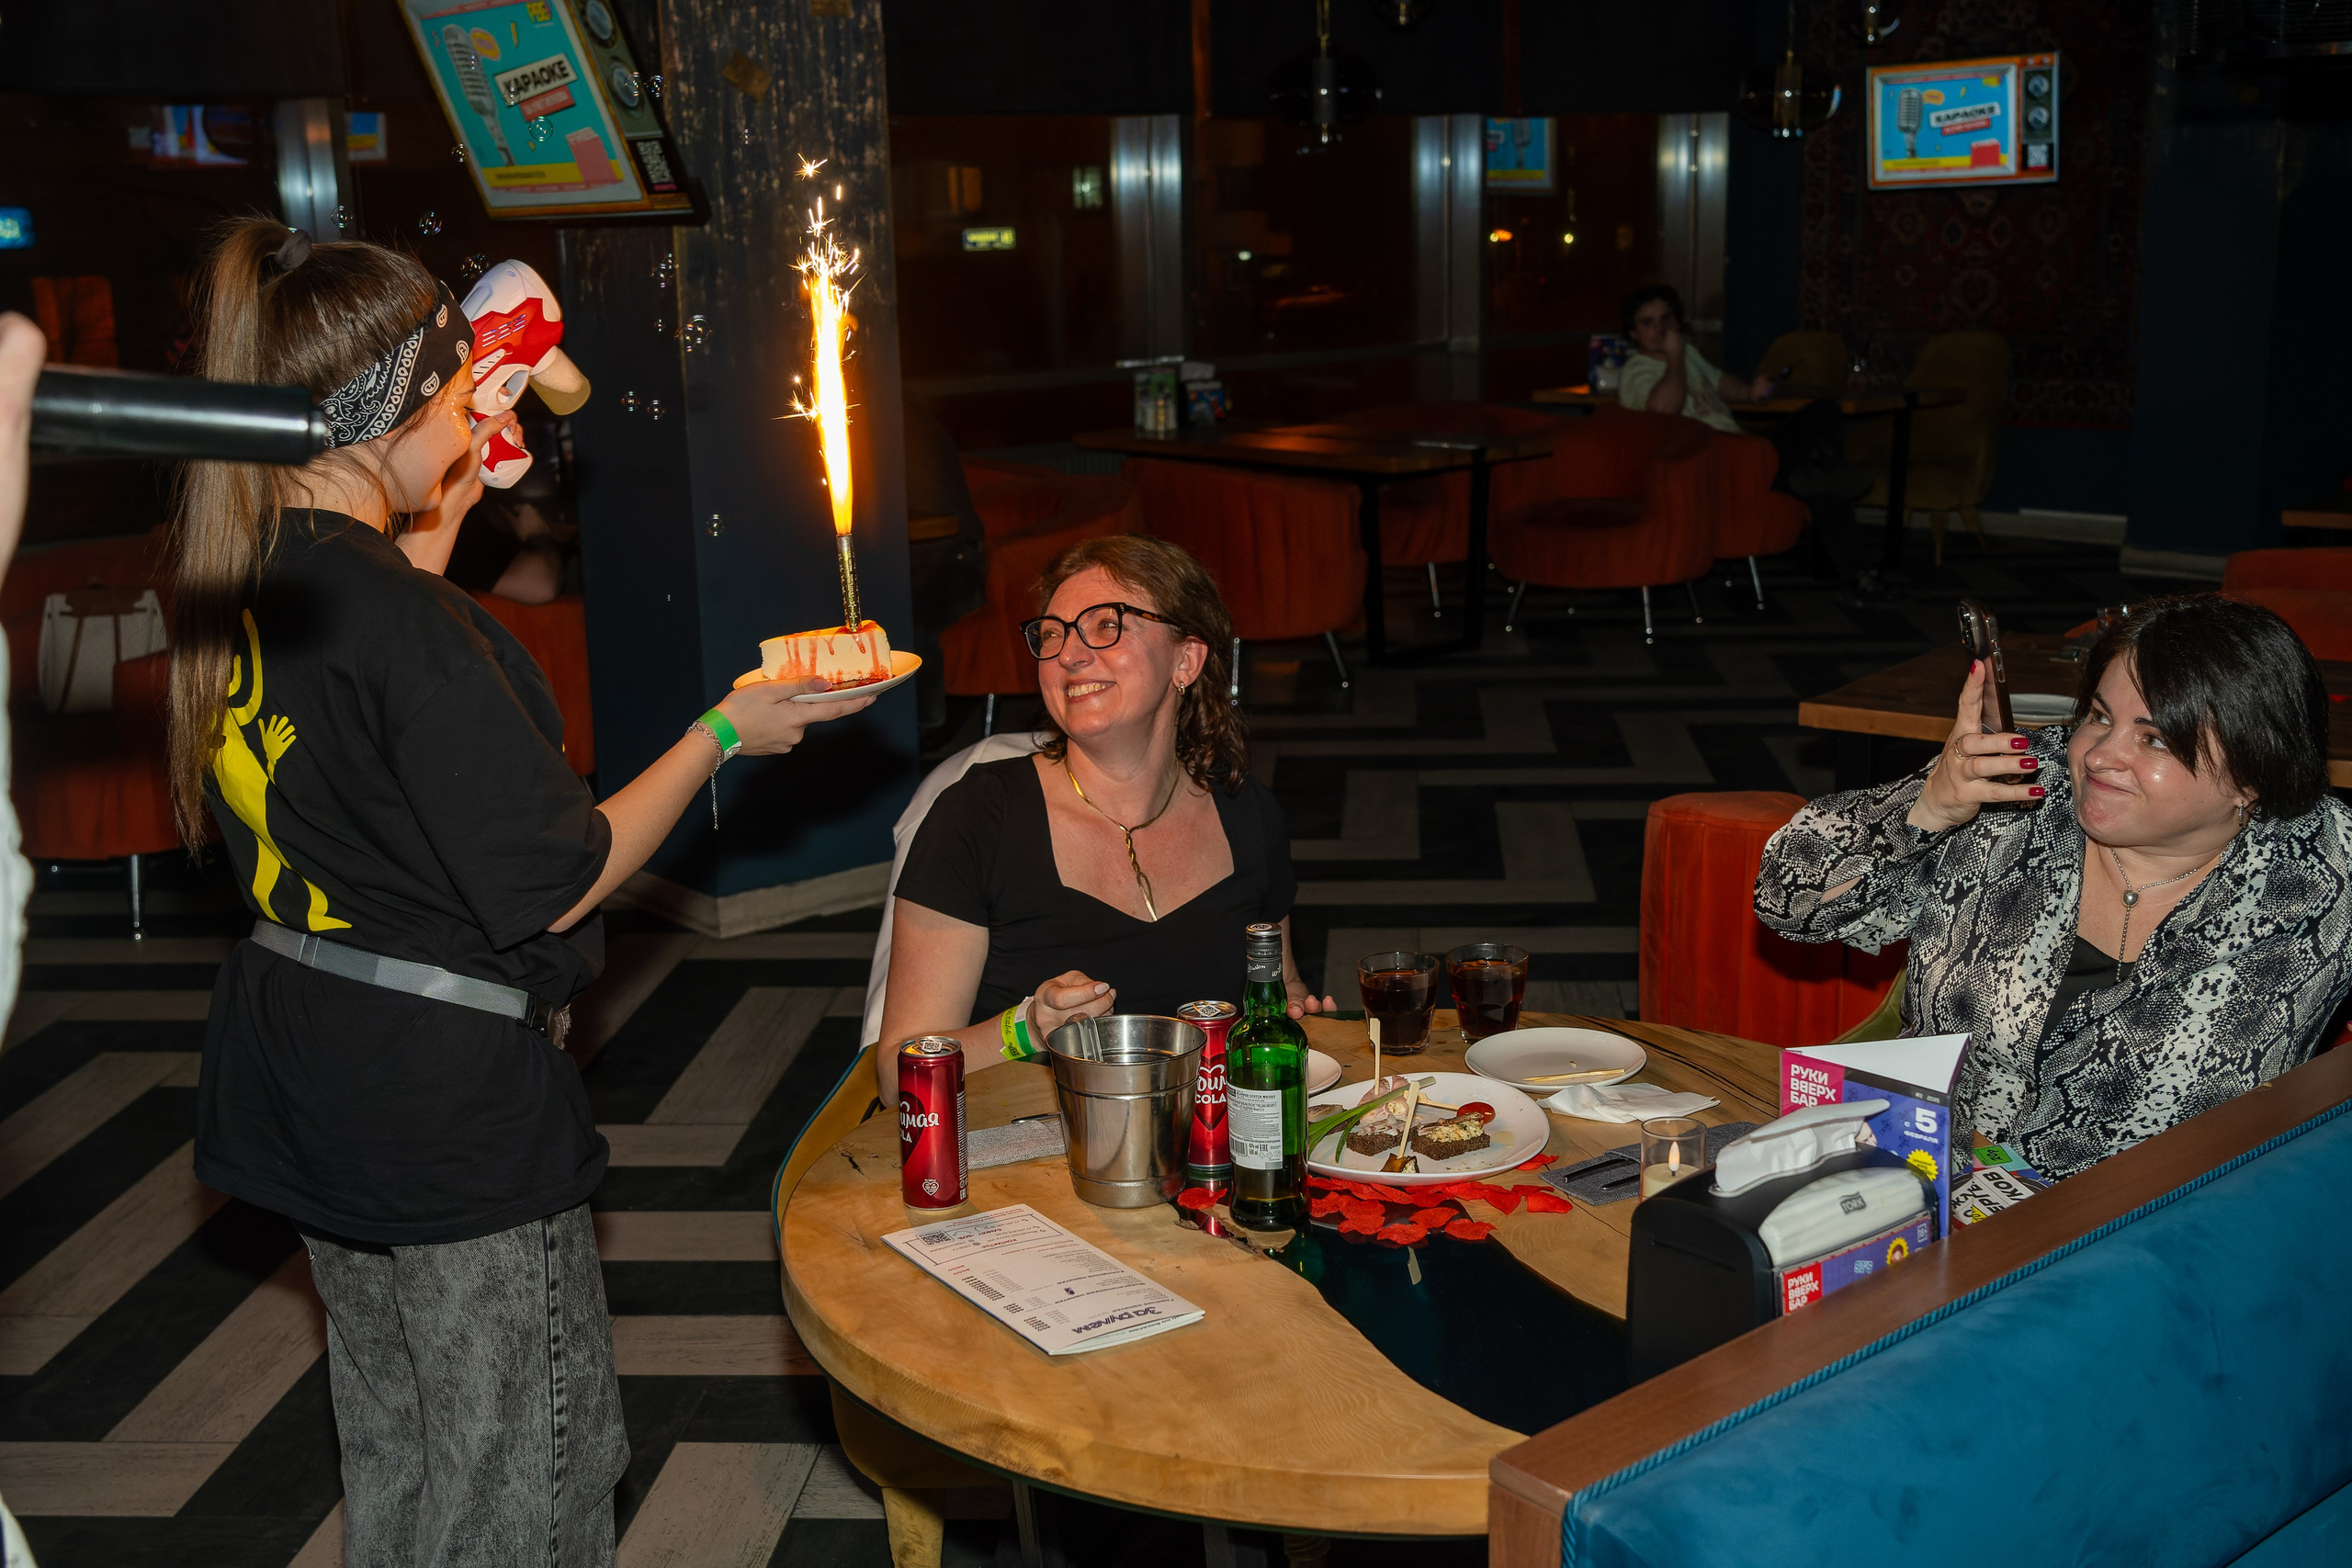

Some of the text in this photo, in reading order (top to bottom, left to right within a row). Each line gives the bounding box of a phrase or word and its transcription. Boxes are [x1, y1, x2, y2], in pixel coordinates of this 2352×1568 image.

[503, 60, 570, 96] КАРАОКЕ
[1791, 1064, 1829, 1085] РУКИ
[1195, 1093, 1227, 1105] COLA
[1790, 1077, 1837, 1102] ВВЕРХ
[1790, 1090, 1818, 1108] БАР
[1915, 1107, 1939, 1134] 5
[1903, 1130, 1939, 1145] ФЕВРАЛЯ
[1842, 1197, 1865, 1213] TORK
[1787, 1270, 1814, 1289] РУКИ
[1787, 1280, 1819, 1300] ВВЕРХ
[1788, 1295, 1808, 1312] БАР
